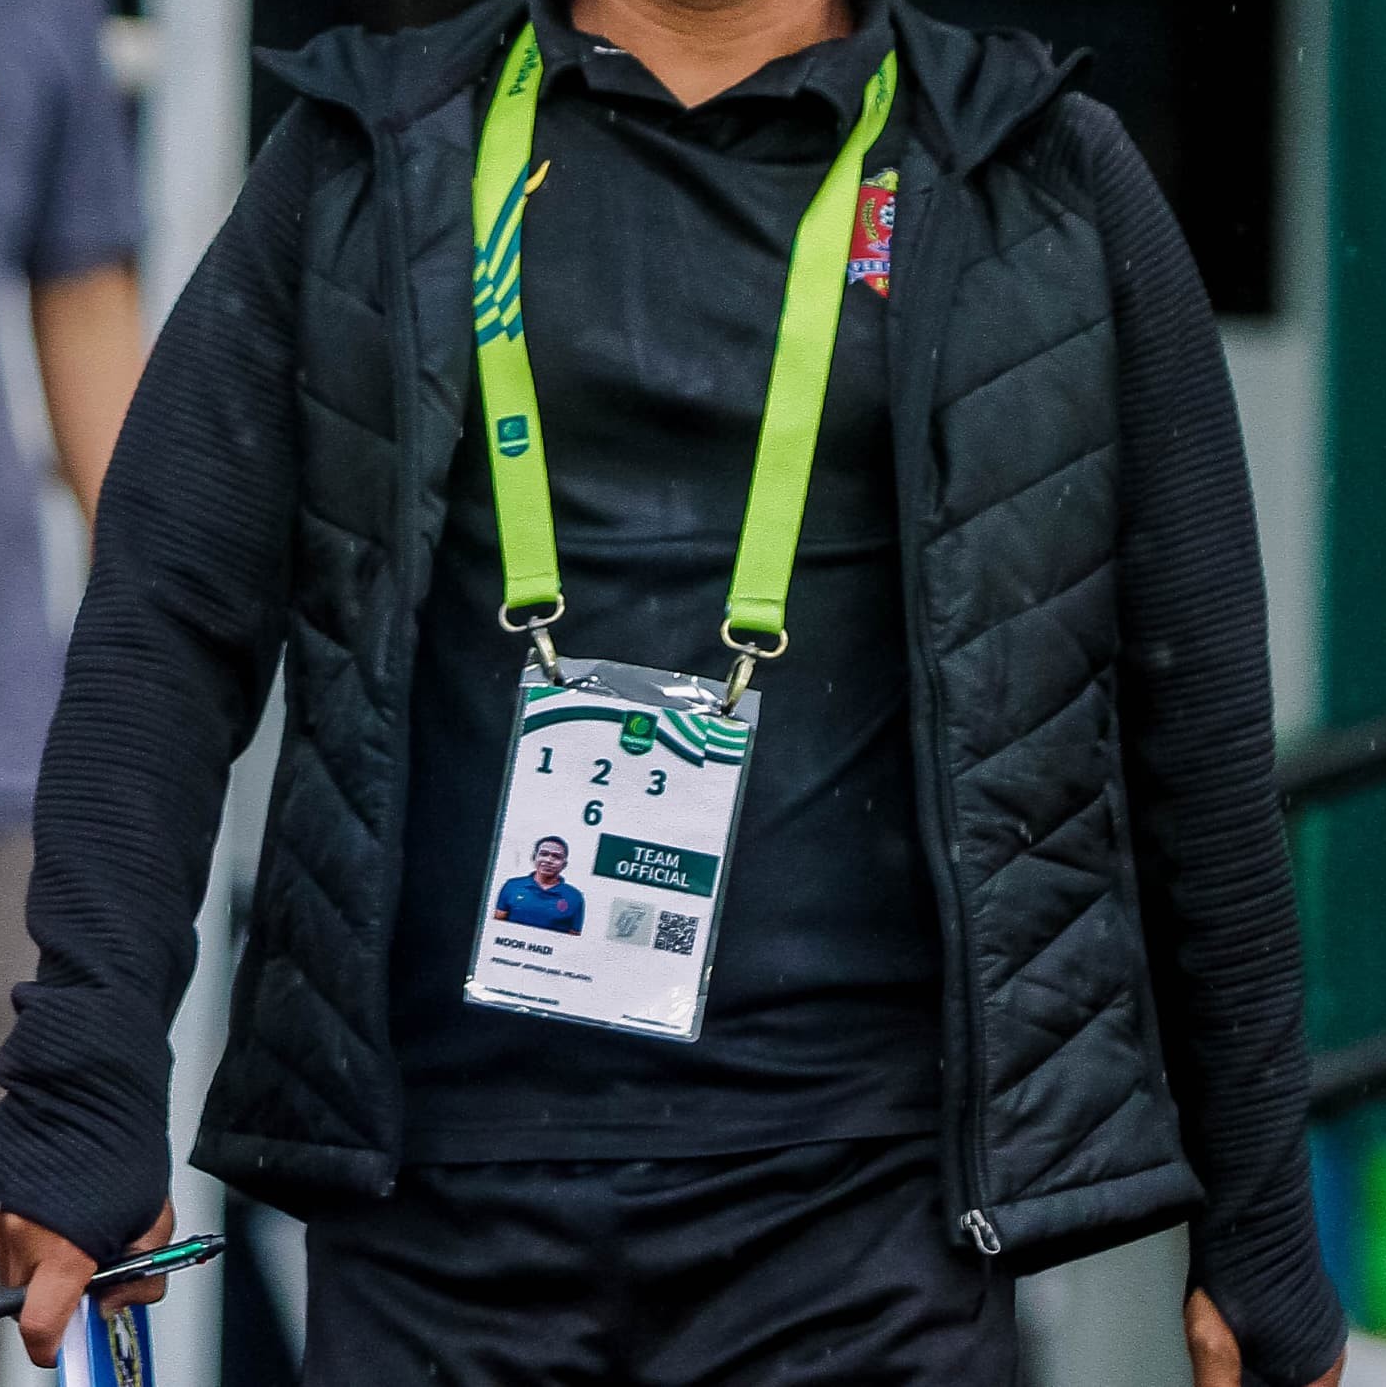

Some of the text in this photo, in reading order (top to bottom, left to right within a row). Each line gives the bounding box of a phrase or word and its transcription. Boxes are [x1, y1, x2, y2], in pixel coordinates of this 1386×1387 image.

[536, 747, 667, 796] 1 2 3
[584, 800, 604, 826] 6
[634, 846, 680, 868] TEAM
[616, 860, 690, 887] OFFICIAL
[495, 937, 553, 955] NOOR HADI
